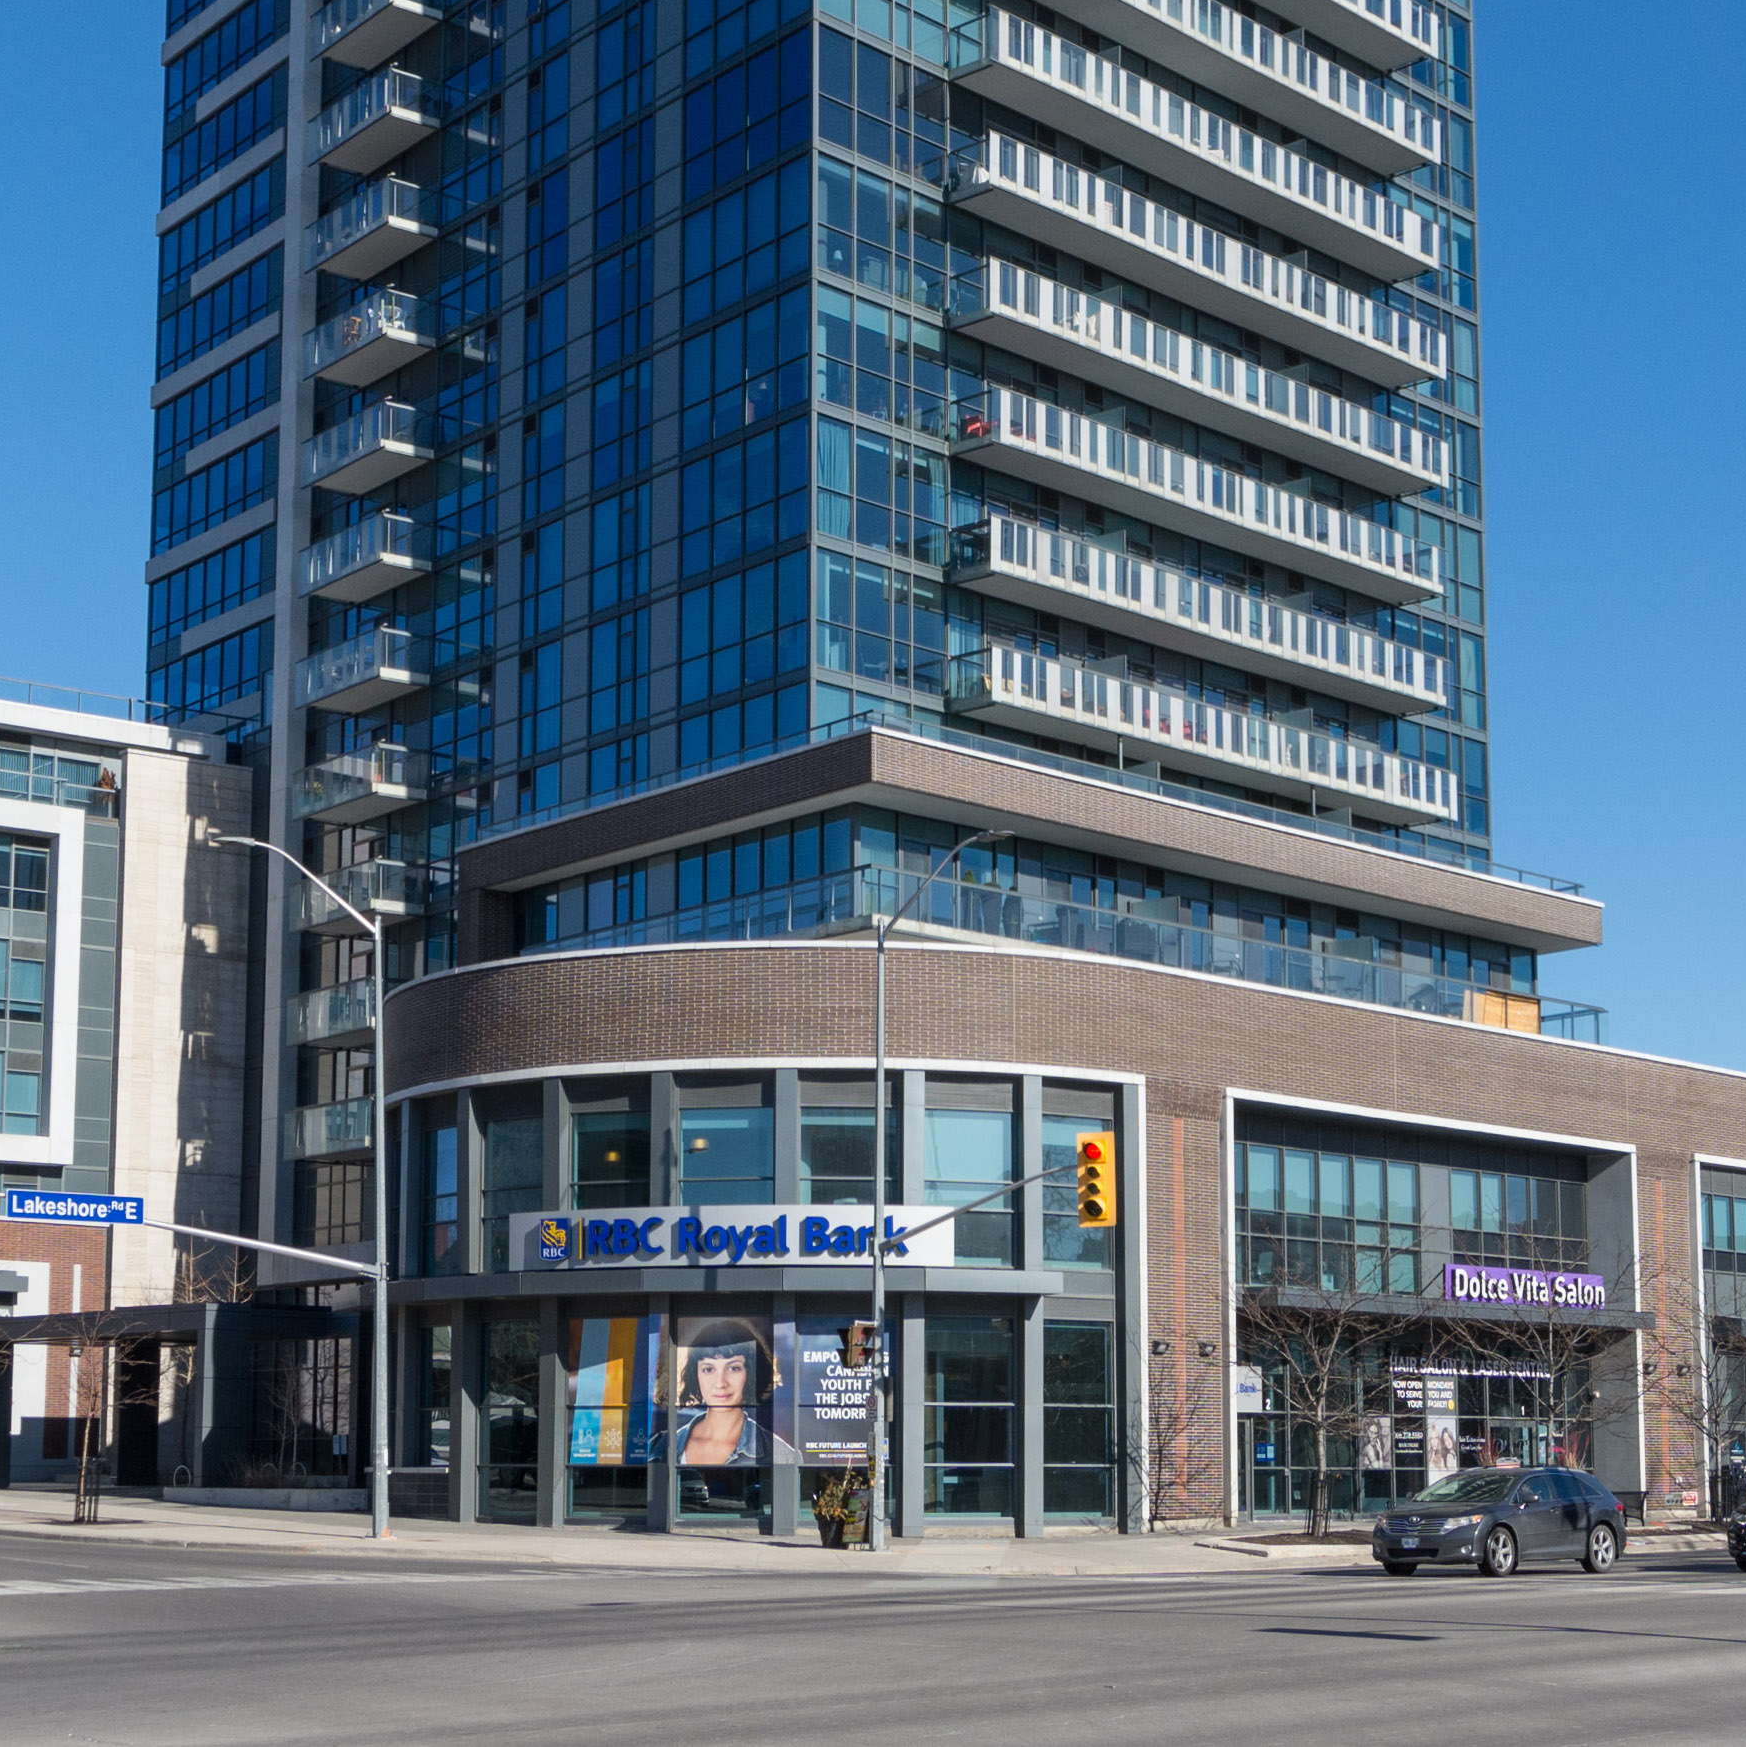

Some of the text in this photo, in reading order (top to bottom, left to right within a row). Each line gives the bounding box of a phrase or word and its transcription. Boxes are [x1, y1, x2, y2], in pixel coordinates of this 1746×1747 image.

[12, 1195, 138, 1220] Lakeshore Rd E
[588, 1217, 665, 1255] RBC
[678, 1214, 790, 1264] Royal
[543, 1247, 565, 1258] RBC
[1455, 1268, 1605, 1307] Dolce Vita Salon
[1389, 1356, 1418, 1373] HAIR
[1419, 1357, 1457, 1375] SALON
[820, 1379, 862, 1390] YOUTH
[1407, 1381, 1423, 1390] OPEN
[814, 1392, 839, 1405] THE
[1397, 1389, 1405, 1399] TO
[1428, 1390, 1454, 1399] YOU AND
[1265, 1398, 1271, 1410] 2
[814, 1407, 867, 1420] TOMORR
